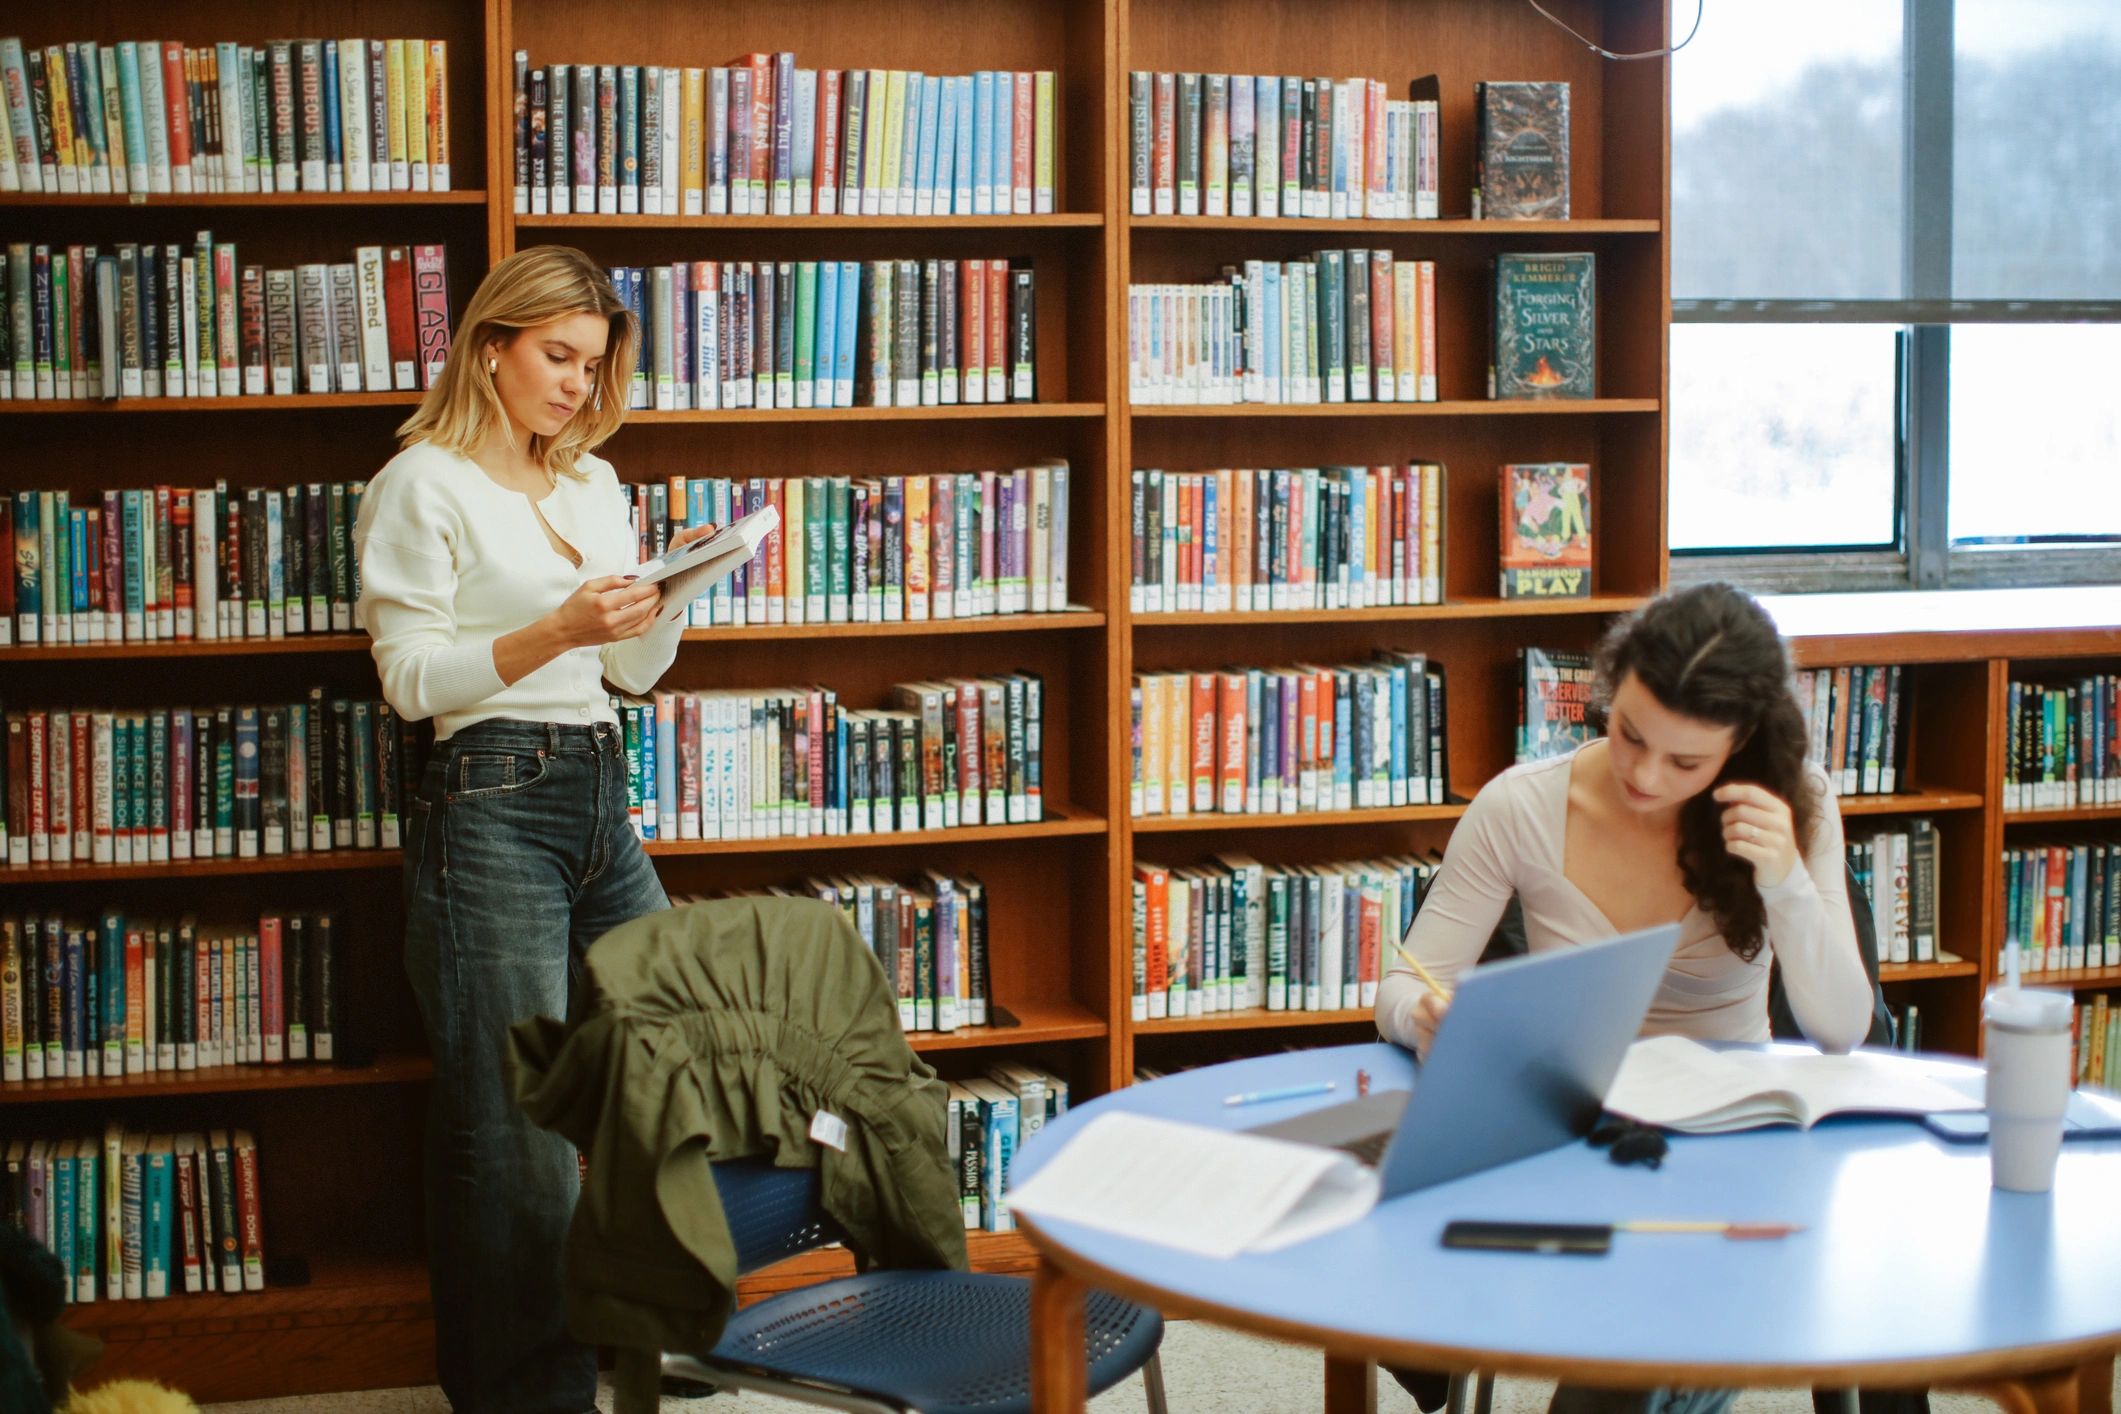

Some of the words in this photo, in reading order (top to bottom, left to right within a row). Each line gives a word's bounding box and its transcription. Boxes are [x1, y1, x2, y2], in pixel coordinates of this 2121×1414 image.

[373, 60, 382, 80] BITE
[57, 101, 67, 124] DARK
[274, 63, 294, 135] HIDEOUS
[303, 63, 320, 134] HIDEOUS
[553, 99, 562, 114] THE
[172, 103, 182, 134] NINE
[375, 101, 384, 135] ROYCE
[848, 114, 859, 151] MILLION
[59, 126, 69, 150] DUDE
[554, 118, 563, 152] WEIGHT
[777, 120, 791, 150] YULI
[554, 156, 563, 167] OF
[846, 169, 857, 186] ONE
[198, 251, 209, 277] KING
[1524, 263, 1565, 273] BRIGID
[198, 295, 211, 322] DEAD
[363, 259, 381, 329] burned
[122, 275, 138, 366] EVERMORE
[269, 276, 293, 361] DENTICAL
[302, 270, 326, 354] DENTICAL
[334, 270, 356, 355] DENTICAL
[702, 305, 715, 333] Out
[898, 290, 912, 344] BEAST
[1522, 309, 1570, 326] SILVER
[1524, 334, 1569, 354] STARS
[229, 521, 238, 577] BELLE
[808, 523, 824, 551] HAND
[832, 522, 846, 551] HAND
[959, 541, 967, 556] MY
[808, 564, 823, 592] WALL
[832, 562, 846, 592] WALL
[1516, 578, 1581, 595] PLAY
[1011, 719, 1022, 737] WE
[31, 728, 42, 789] SOMETHING
[117, 736, 128, 790] SILENCE
[134, 735, 144, 788] SILENCE
[152, 730, 164, 788] SILENCE
[1011, 741, 1022, 761] FLY
[33, 790, 43, 813] LIKE
[242, 1156, 254, 1200] SURVIVE
[966, 1151, 979, 1188] PASSION
[153, 1201, 161, 1222] OWN
[61, 1211, 72, 1253] WHOLE
[246, 1214, 257, 1245] DOME
